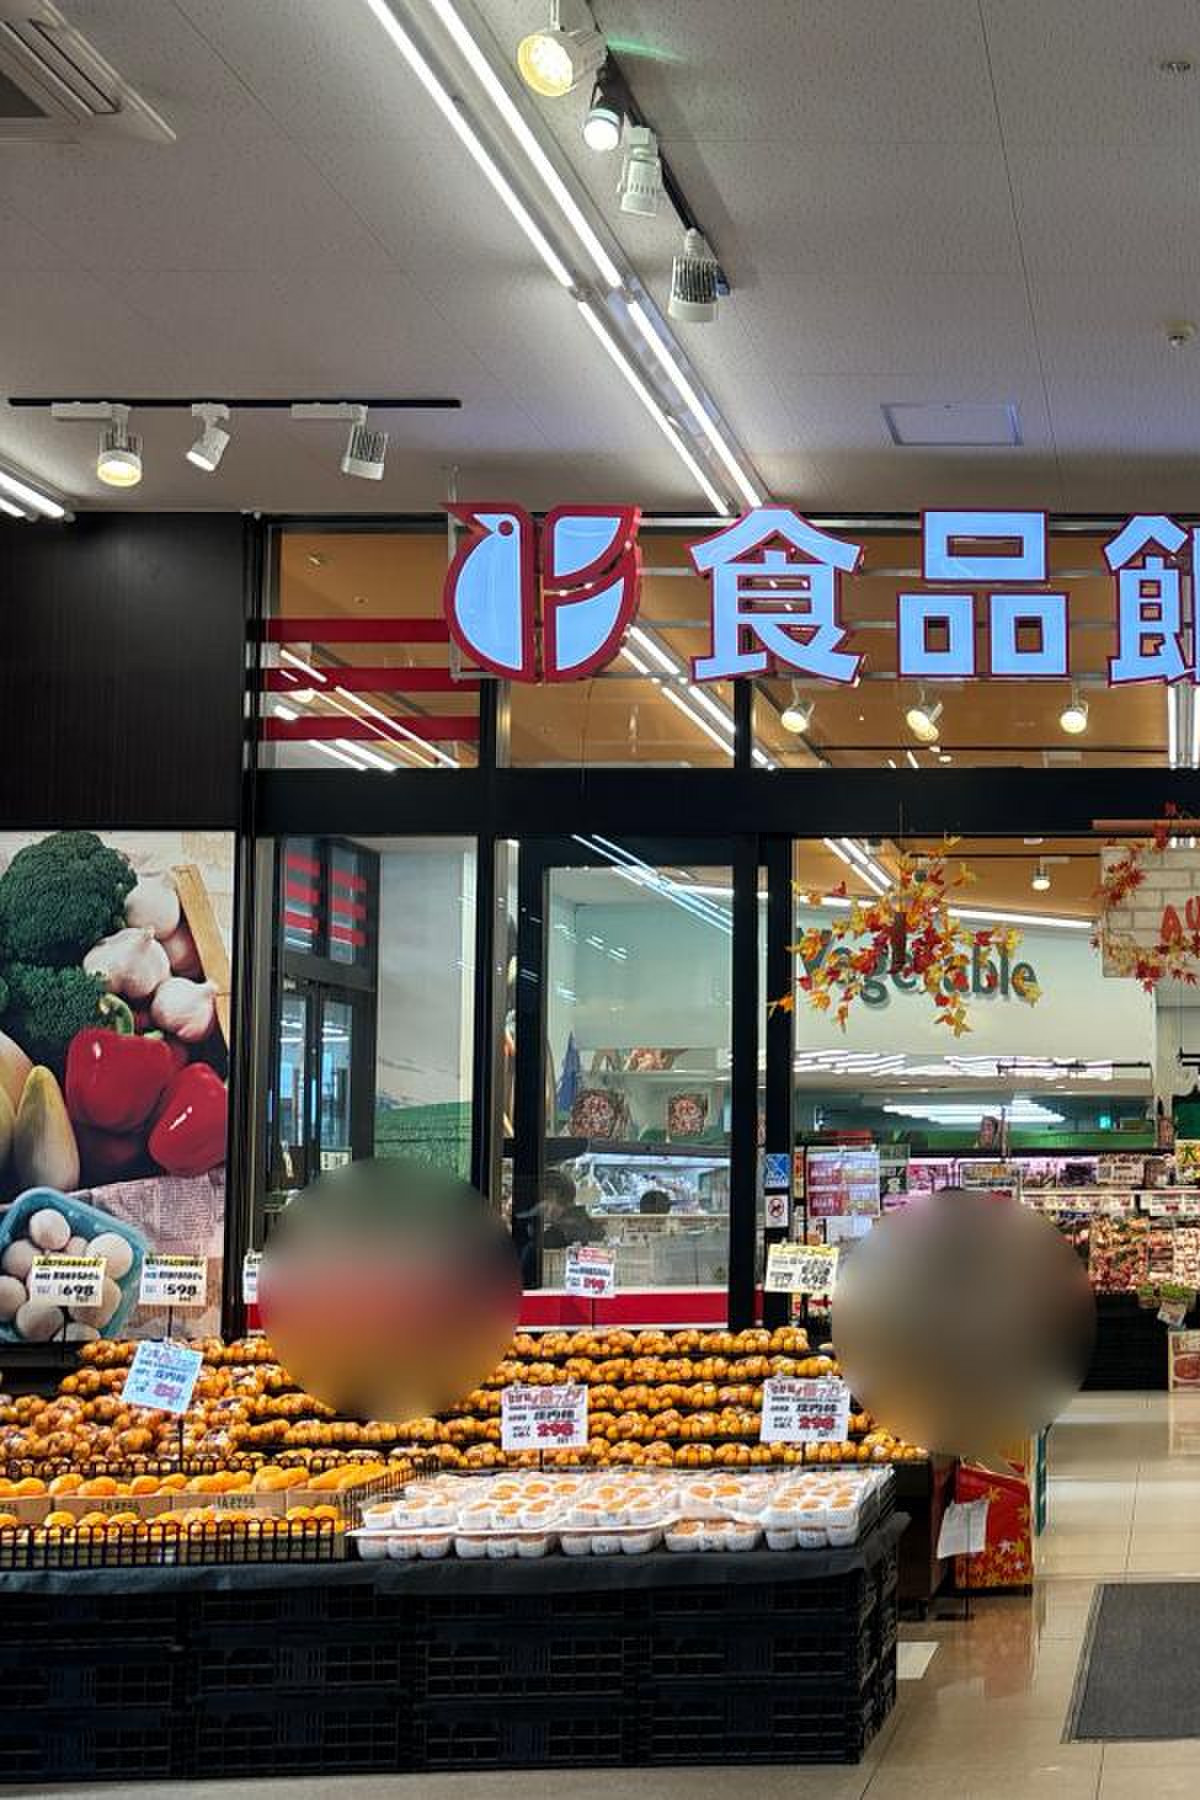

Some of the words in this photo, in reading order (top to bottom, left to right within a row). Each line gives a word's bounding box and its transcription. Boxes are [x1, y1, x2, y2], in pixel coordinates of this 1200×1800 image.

[800, 928, 1041, 1003] Vgeable
[62, 1285, 94, 1297] 698
[166, 1284, 197, 1296] 598
